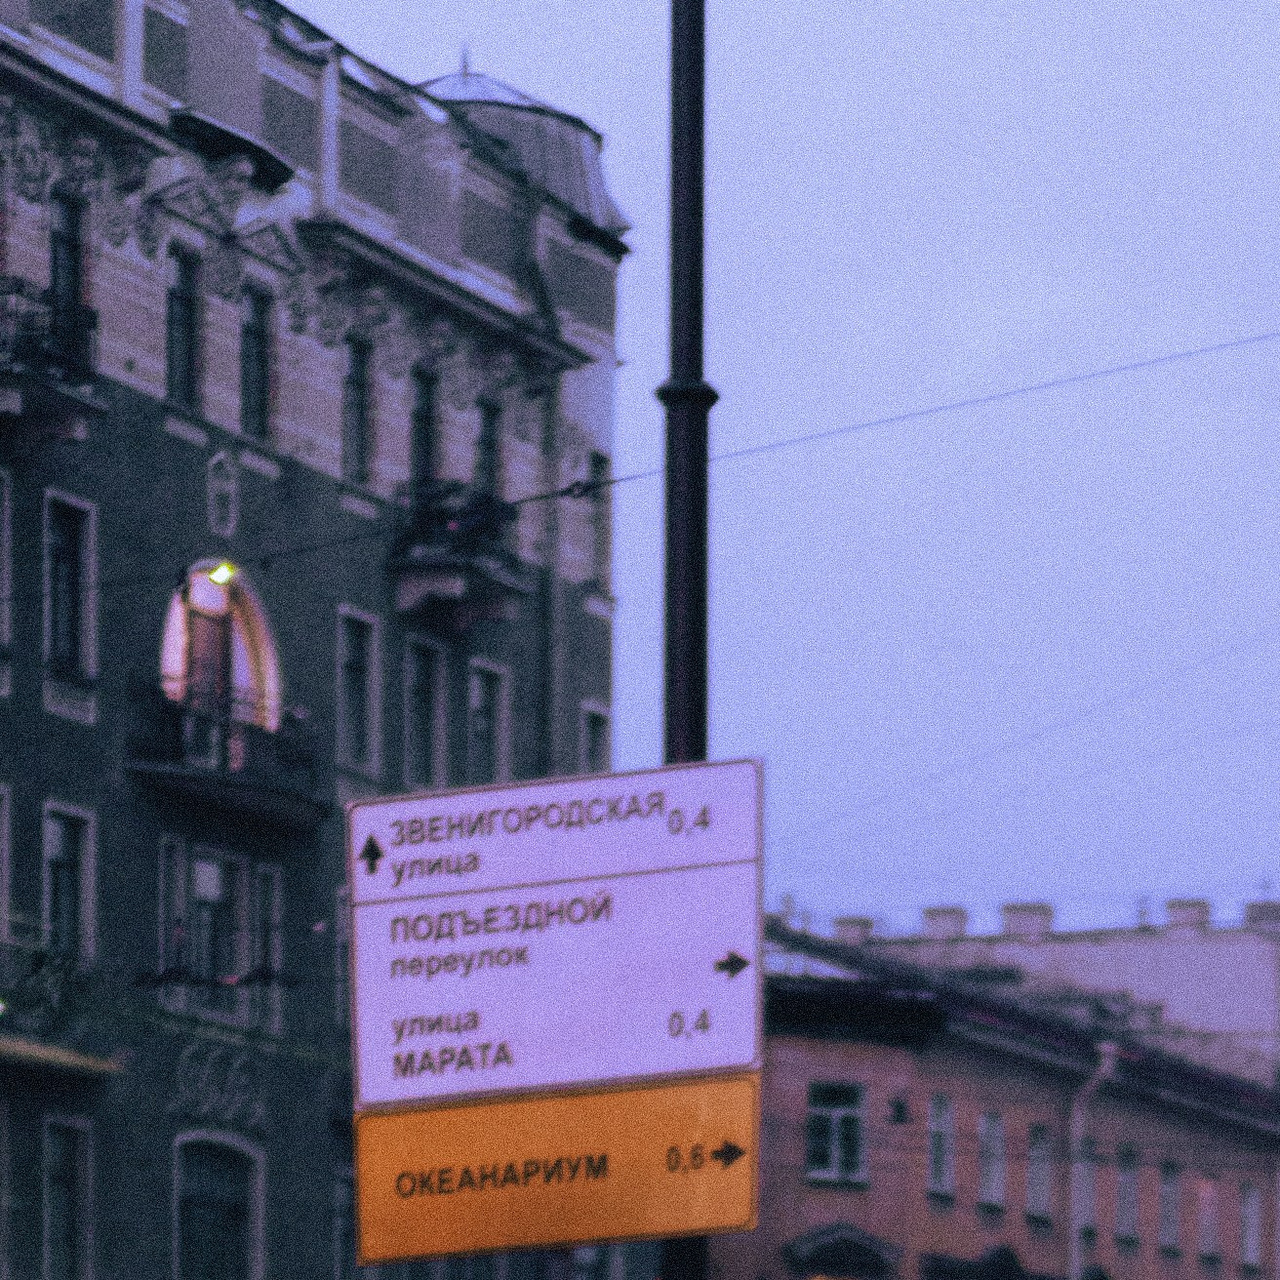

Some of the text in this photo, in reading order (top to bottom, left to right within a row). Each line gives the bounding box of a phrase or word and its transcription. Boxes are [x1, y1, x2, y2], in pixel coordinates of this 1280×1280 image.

[390, 790, 666, 848] ЗВЕНИГОРОДСКАЯ
[667, 804, 712, 836] 0,4
[391, 852, 481, 888] улица
[389, 889, 613, 943] ПОДЪЕЗДНОЙ
[389, 945, 530, 981] переулок
[391, 1009, 481, 1045] улица
[667, 1008, 712, 1041] 0,4
[391, 1041, 514, 1078] МАРАТА
[395, 1152, 609, 1200] ОКЕАНАРИУМ
